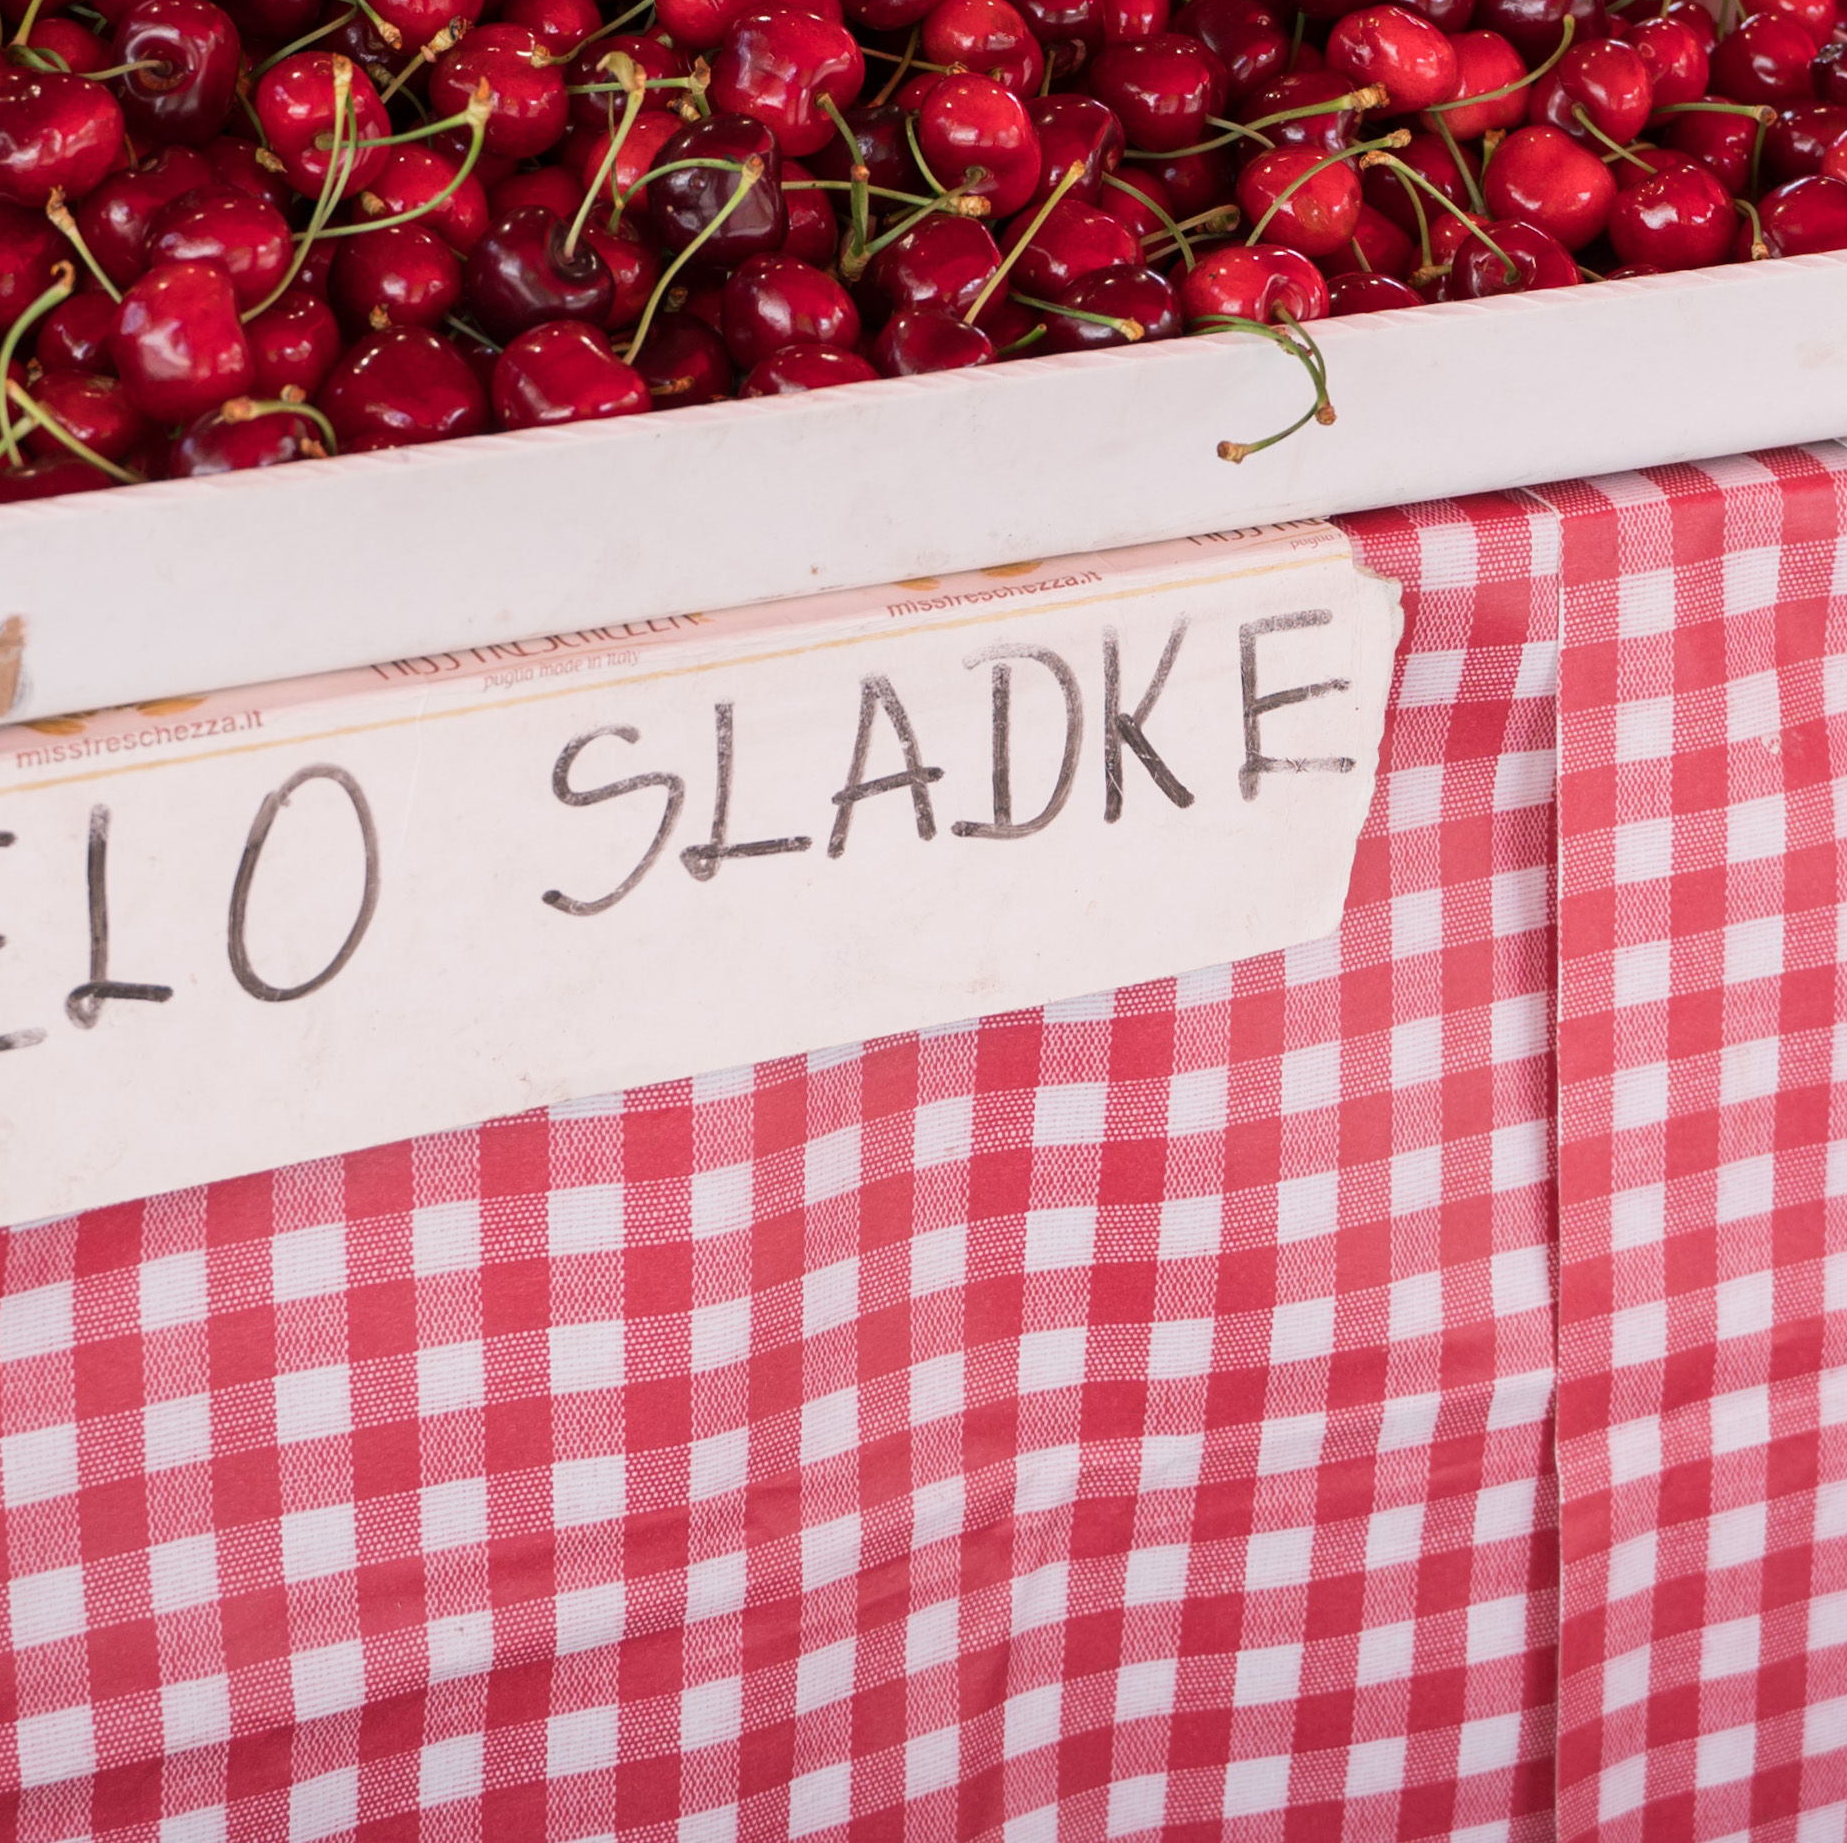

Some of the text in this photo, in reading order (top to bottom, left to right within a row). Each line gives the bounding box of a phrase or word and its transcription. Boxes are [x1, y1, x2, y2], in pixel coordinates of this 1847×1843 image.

[483, 664, 534, 693] puglia
[539, 658, 584, 678] made
[587, 654, 602, 669] in
[541, 608, 1357, 917] SLADKE
